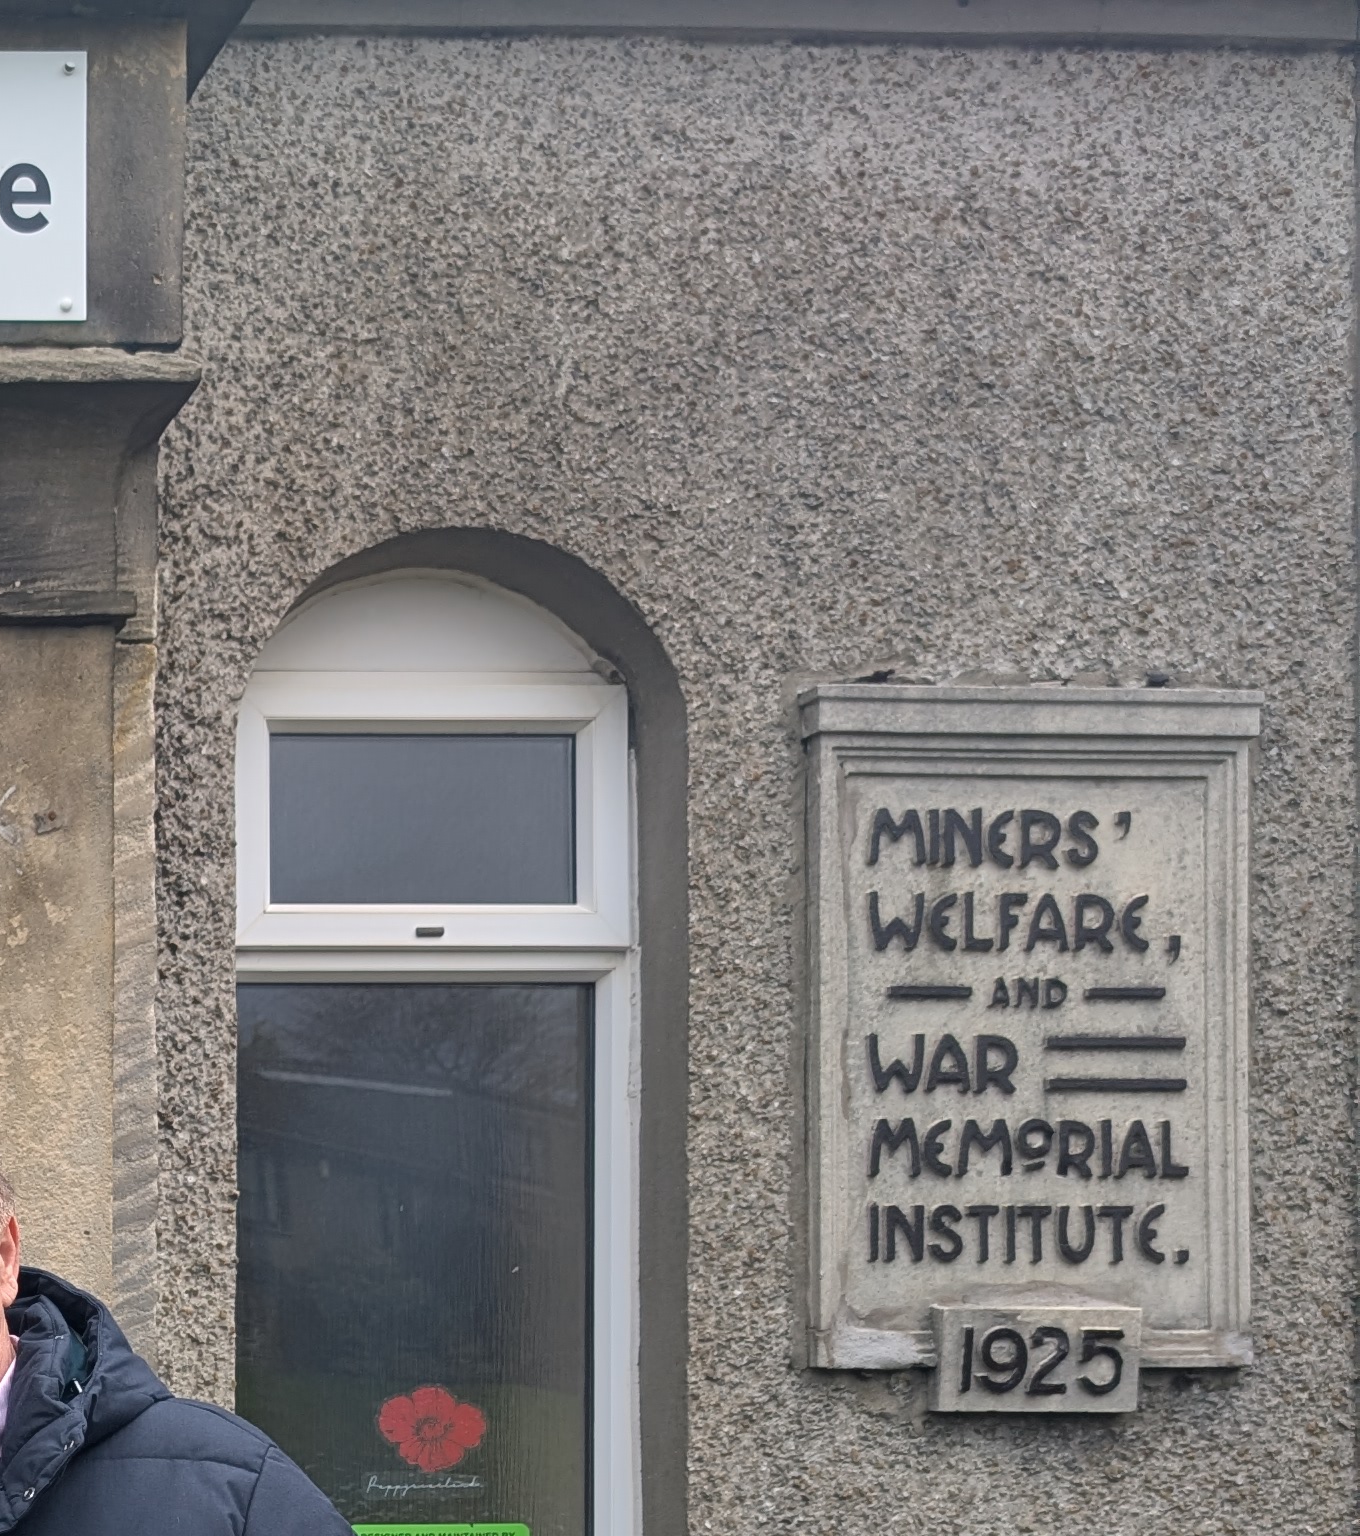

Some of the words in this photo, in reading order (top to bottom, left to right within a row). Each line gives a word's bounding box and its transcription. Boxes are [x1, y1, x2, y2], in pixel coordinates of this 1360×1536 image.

[865, 806, 1133, 869] MINERS'
[865, 891, 1181, 964] WELFARE,
[987, 976, 1068, 1010] AND
[865, 1032, 1018, 1093] WAR
[867, 1116, 1189, 1180] MEMORIAL
[866, 1203, 1190, 1266] INSTITUTE.
[959, 1325, 1125, 1396] 1925
